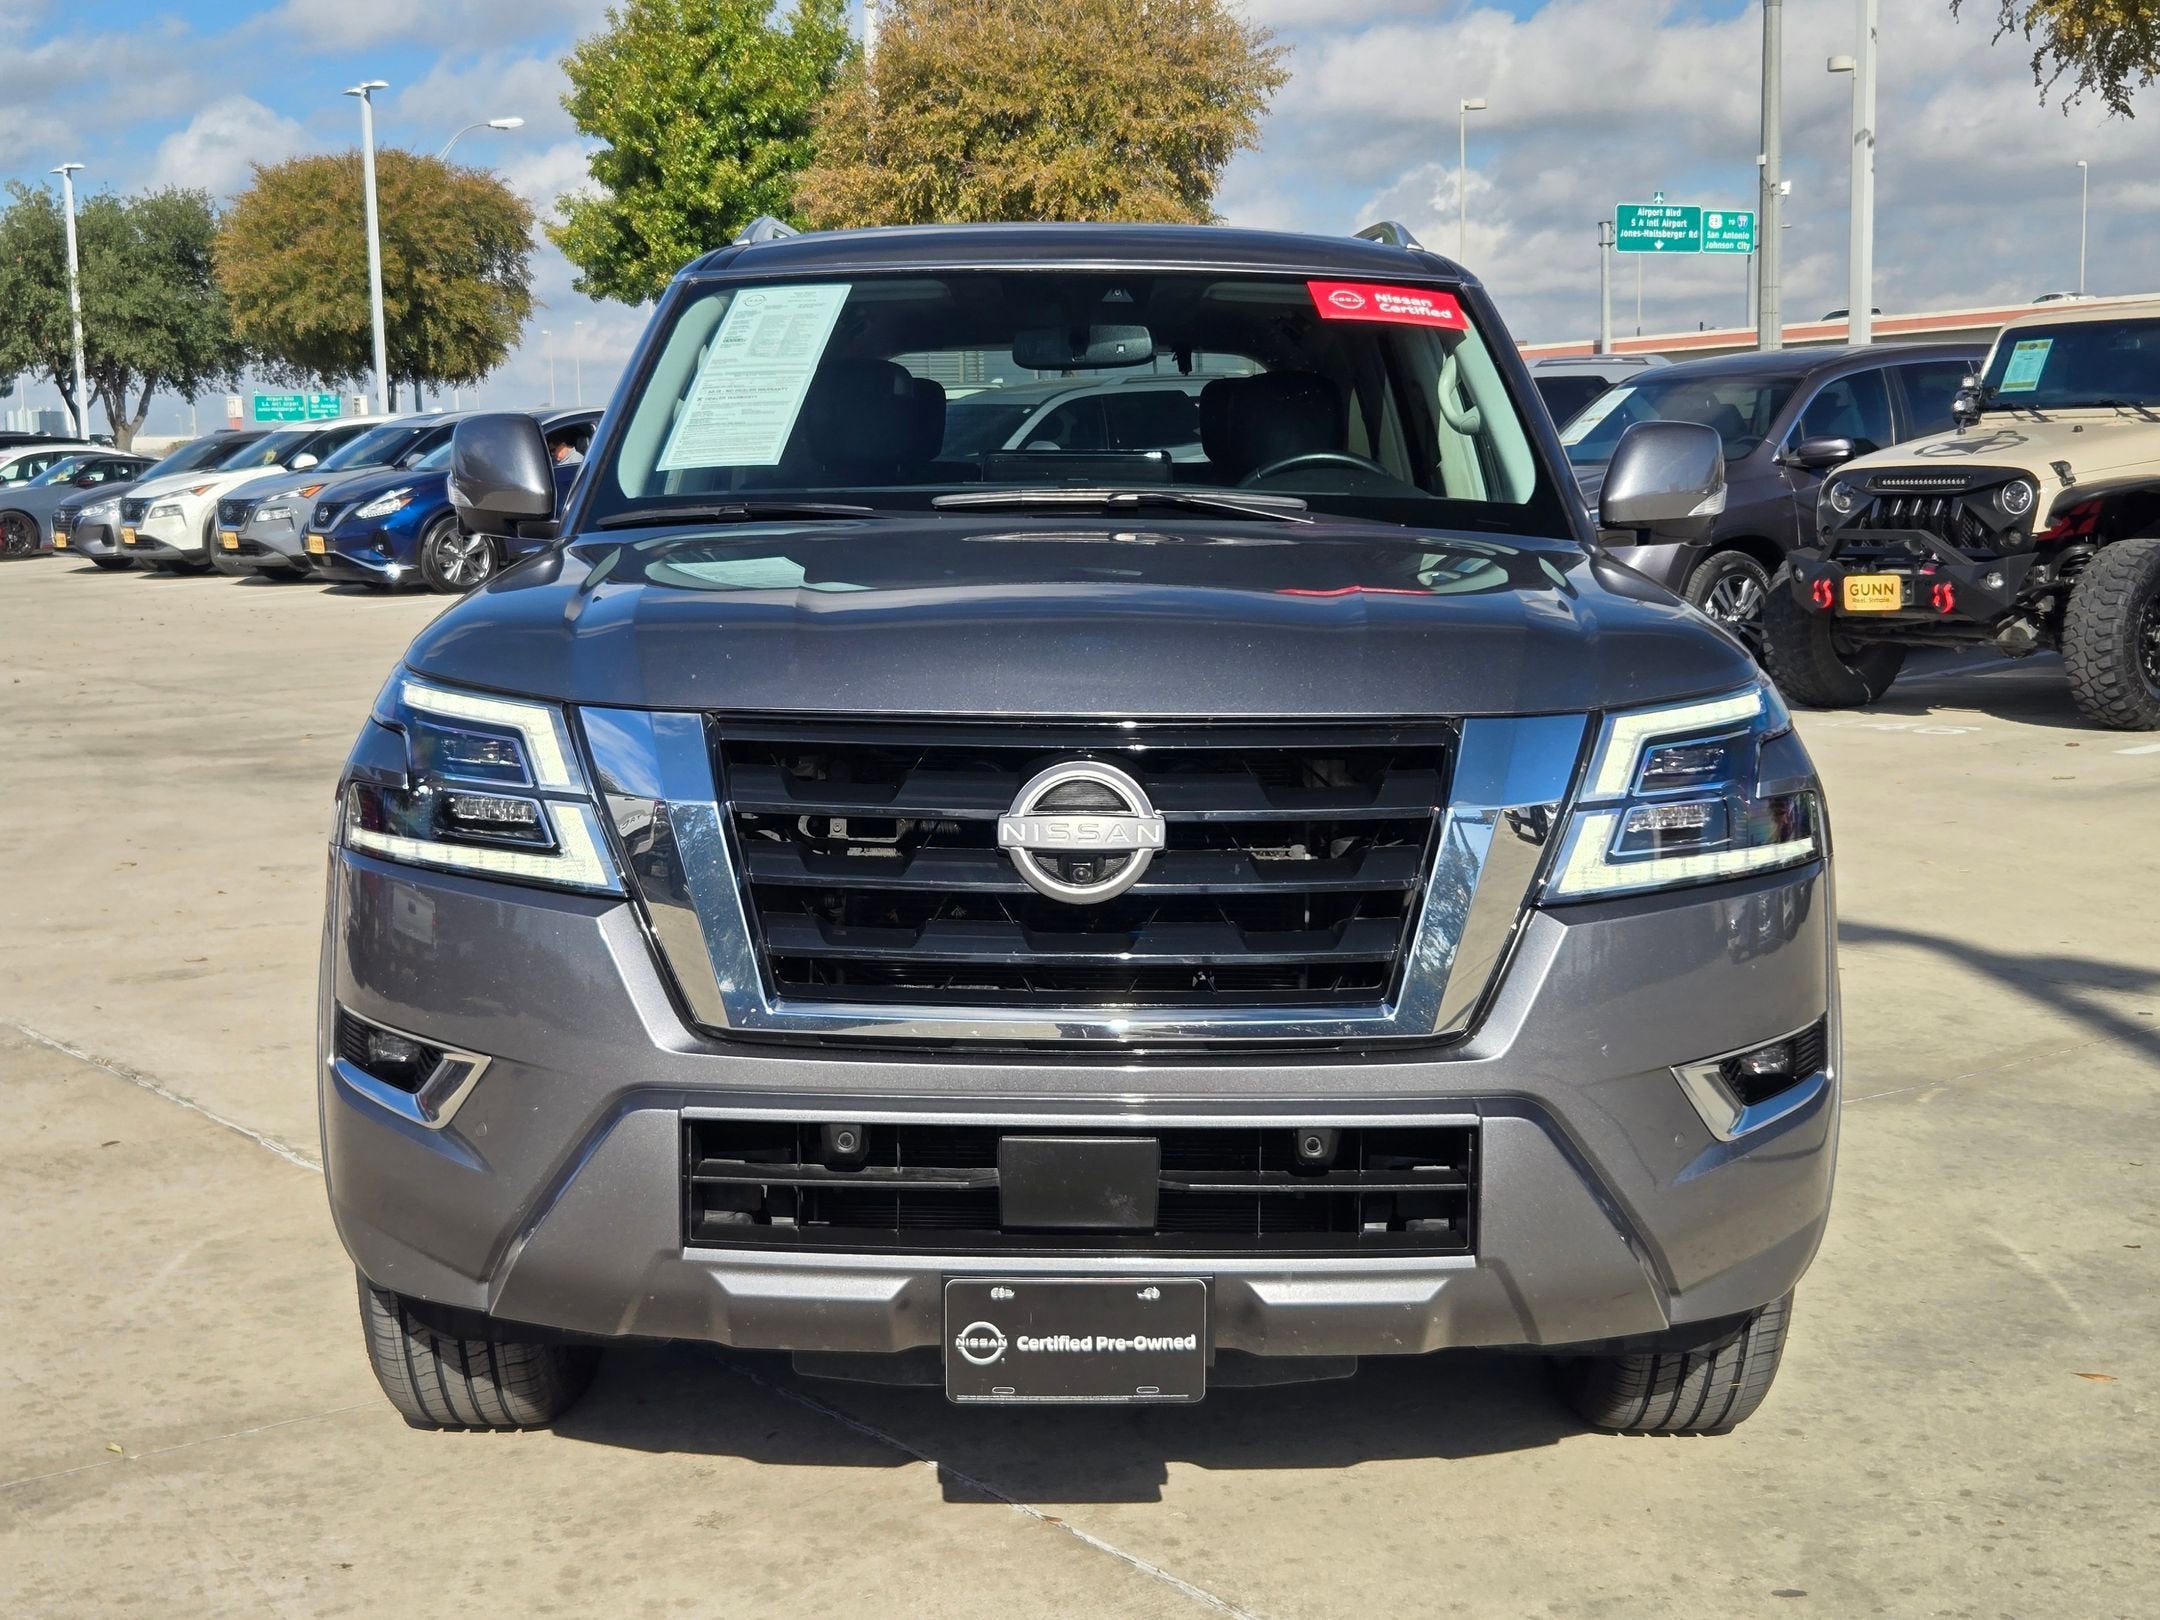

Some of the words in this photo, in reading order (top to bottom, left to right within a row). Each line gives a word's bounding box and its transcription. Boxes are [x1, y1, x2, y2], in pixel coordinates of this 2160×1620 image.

[1637, 207, 1663, 218] Airport
[1662, 219, 1687, 229] Airport
[1722, 231, 1750, 240] Antonio
[1705, 241, 1734, 249] Johnson
[1737, 241, 1751, 251] City
[1374, 293, 1433, 307] Nissan
[1379, 303, 1453, 319] Certified
[1849, 583, 1894, 596] GUNN
[1002, 822, 1160, 843] NISSAN
[955, 1337, 1008, 1348] NISSAN
[1016, 1335, 1093, 1352] Certified
[1096, 1334, 1197, 1351] Pre-Owned
